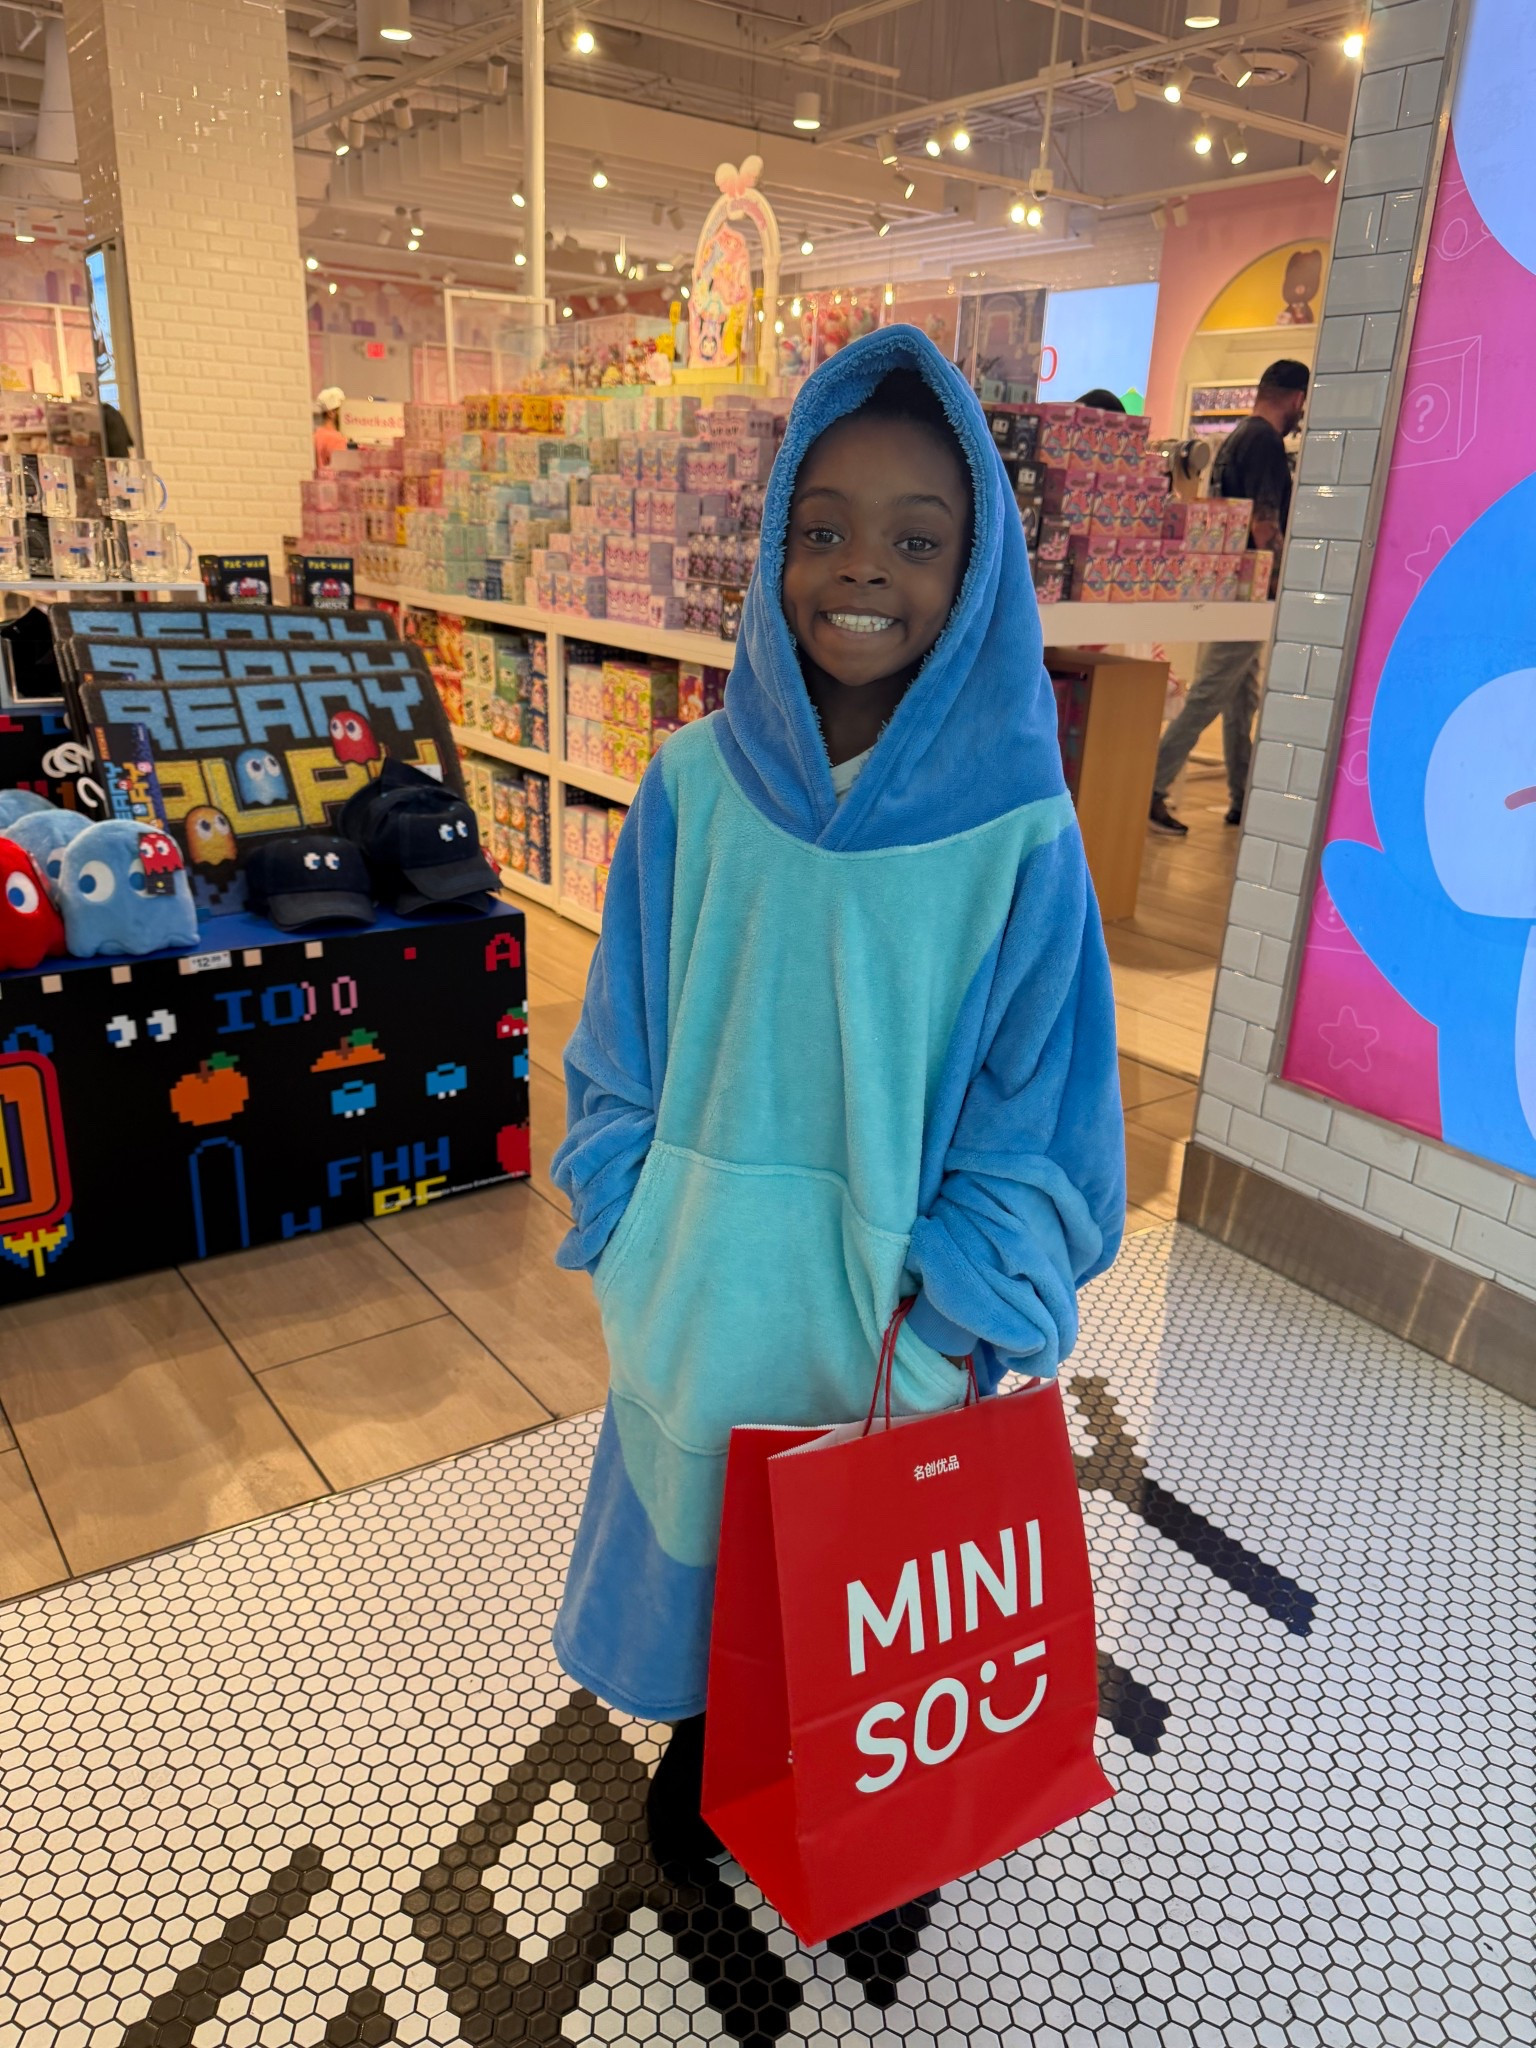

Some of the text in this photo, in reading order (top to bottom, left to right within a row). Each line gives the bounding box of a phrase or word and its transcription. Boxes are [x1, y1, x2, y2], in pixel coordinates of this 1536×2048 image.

[914, 1454, 960, 1481] 名创优品
[846, 1518, 1044, 1677] MINI
